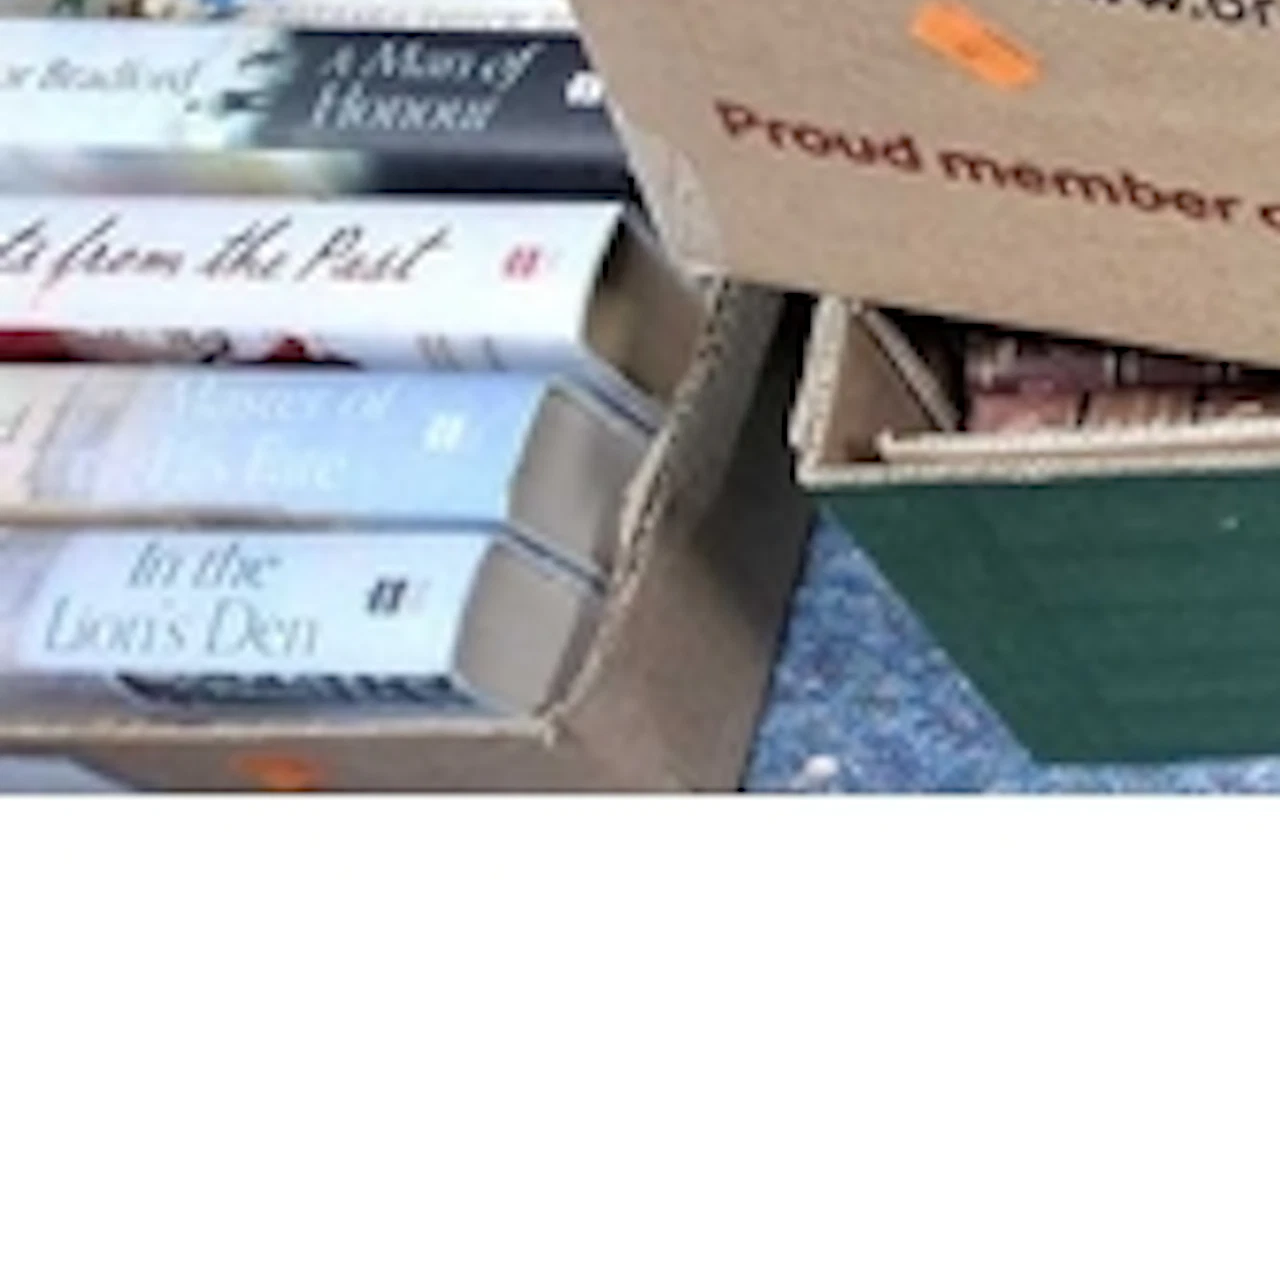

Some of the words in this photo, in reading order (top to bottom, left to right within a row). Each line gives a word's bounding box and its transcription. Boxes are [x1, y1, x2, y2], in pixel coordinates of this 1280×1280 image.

[310, 84, 502, 132] Honour
[716, 97, 922, 174] Proud
[938, 144, 1240, 227] member
[36, 212, 186, 294] from
[197, 211, 293, 283] the
[294, 221, 454, 284] Past
[123, 539, 181, 591] In
[191, 539, 284, 590] the
[42, 592, 194, 657] Lion's
[204, 596, 320, 658] Den
